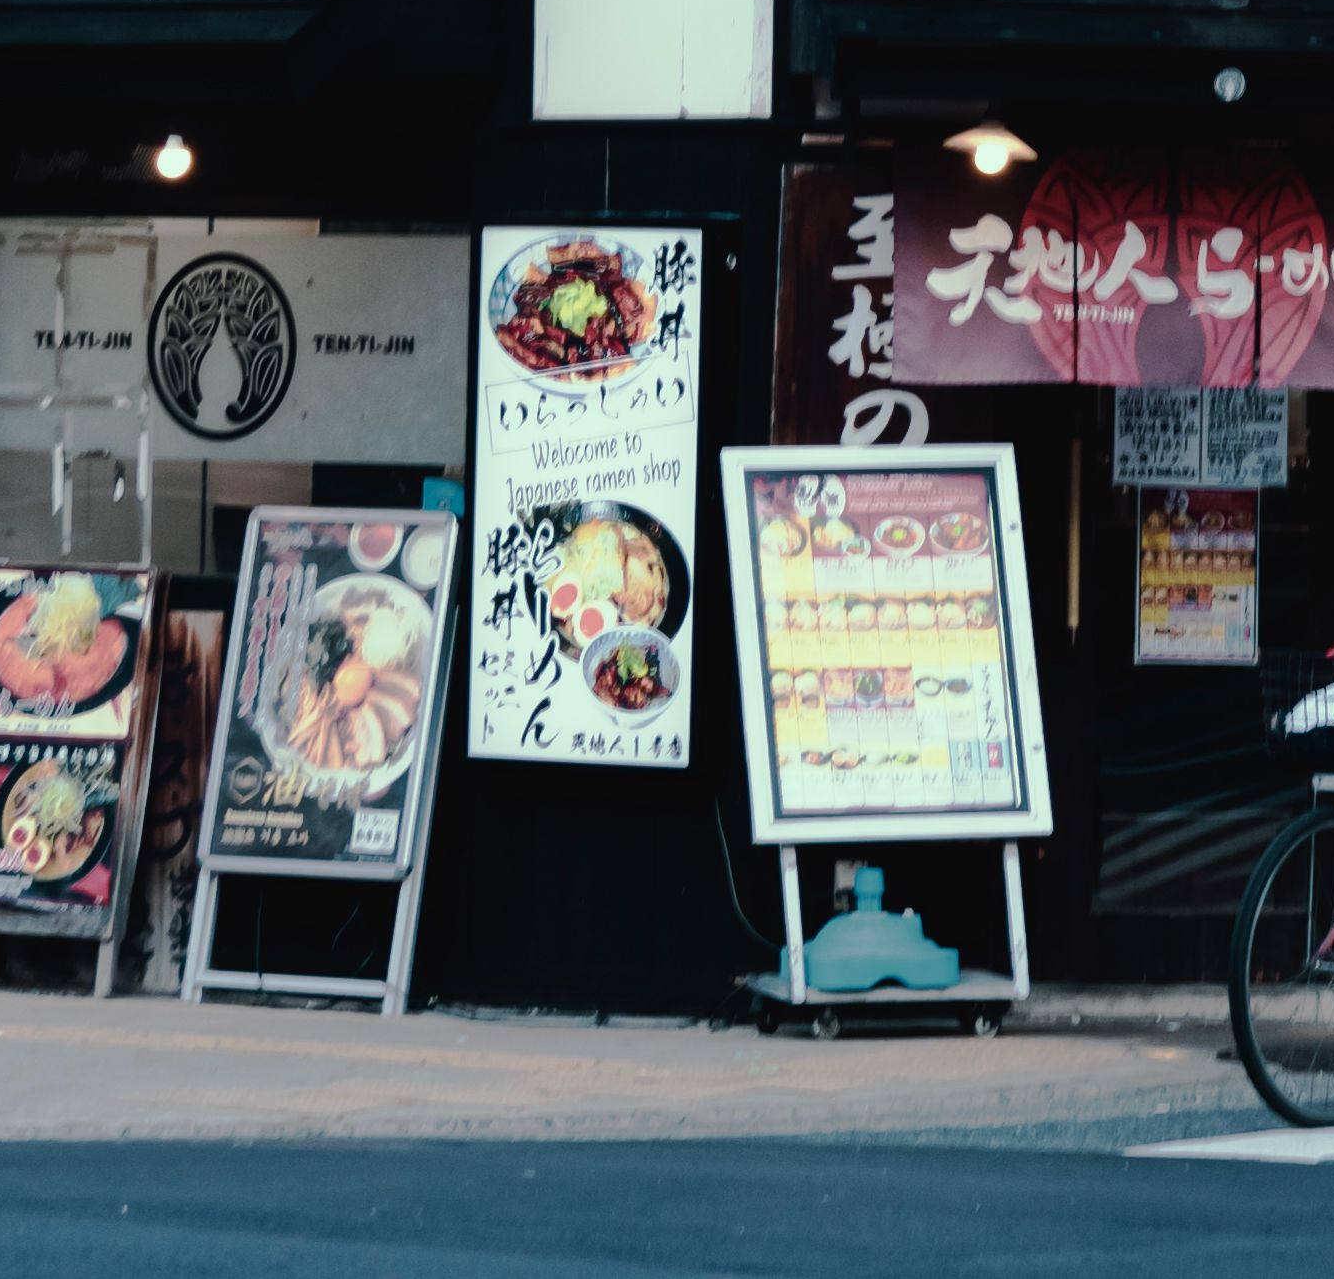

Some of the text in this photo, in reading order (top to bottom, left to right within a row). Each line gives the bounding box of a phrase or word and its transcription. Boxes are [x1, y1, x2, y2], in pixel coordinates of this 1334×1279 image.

[926, 212, 1179, 326] 天地人
[312, 332, 415, 355] TEN-TI-JIN
[625, 431, 643, 455] to
[505, 453, 682, 516] Japanese ramen shop
